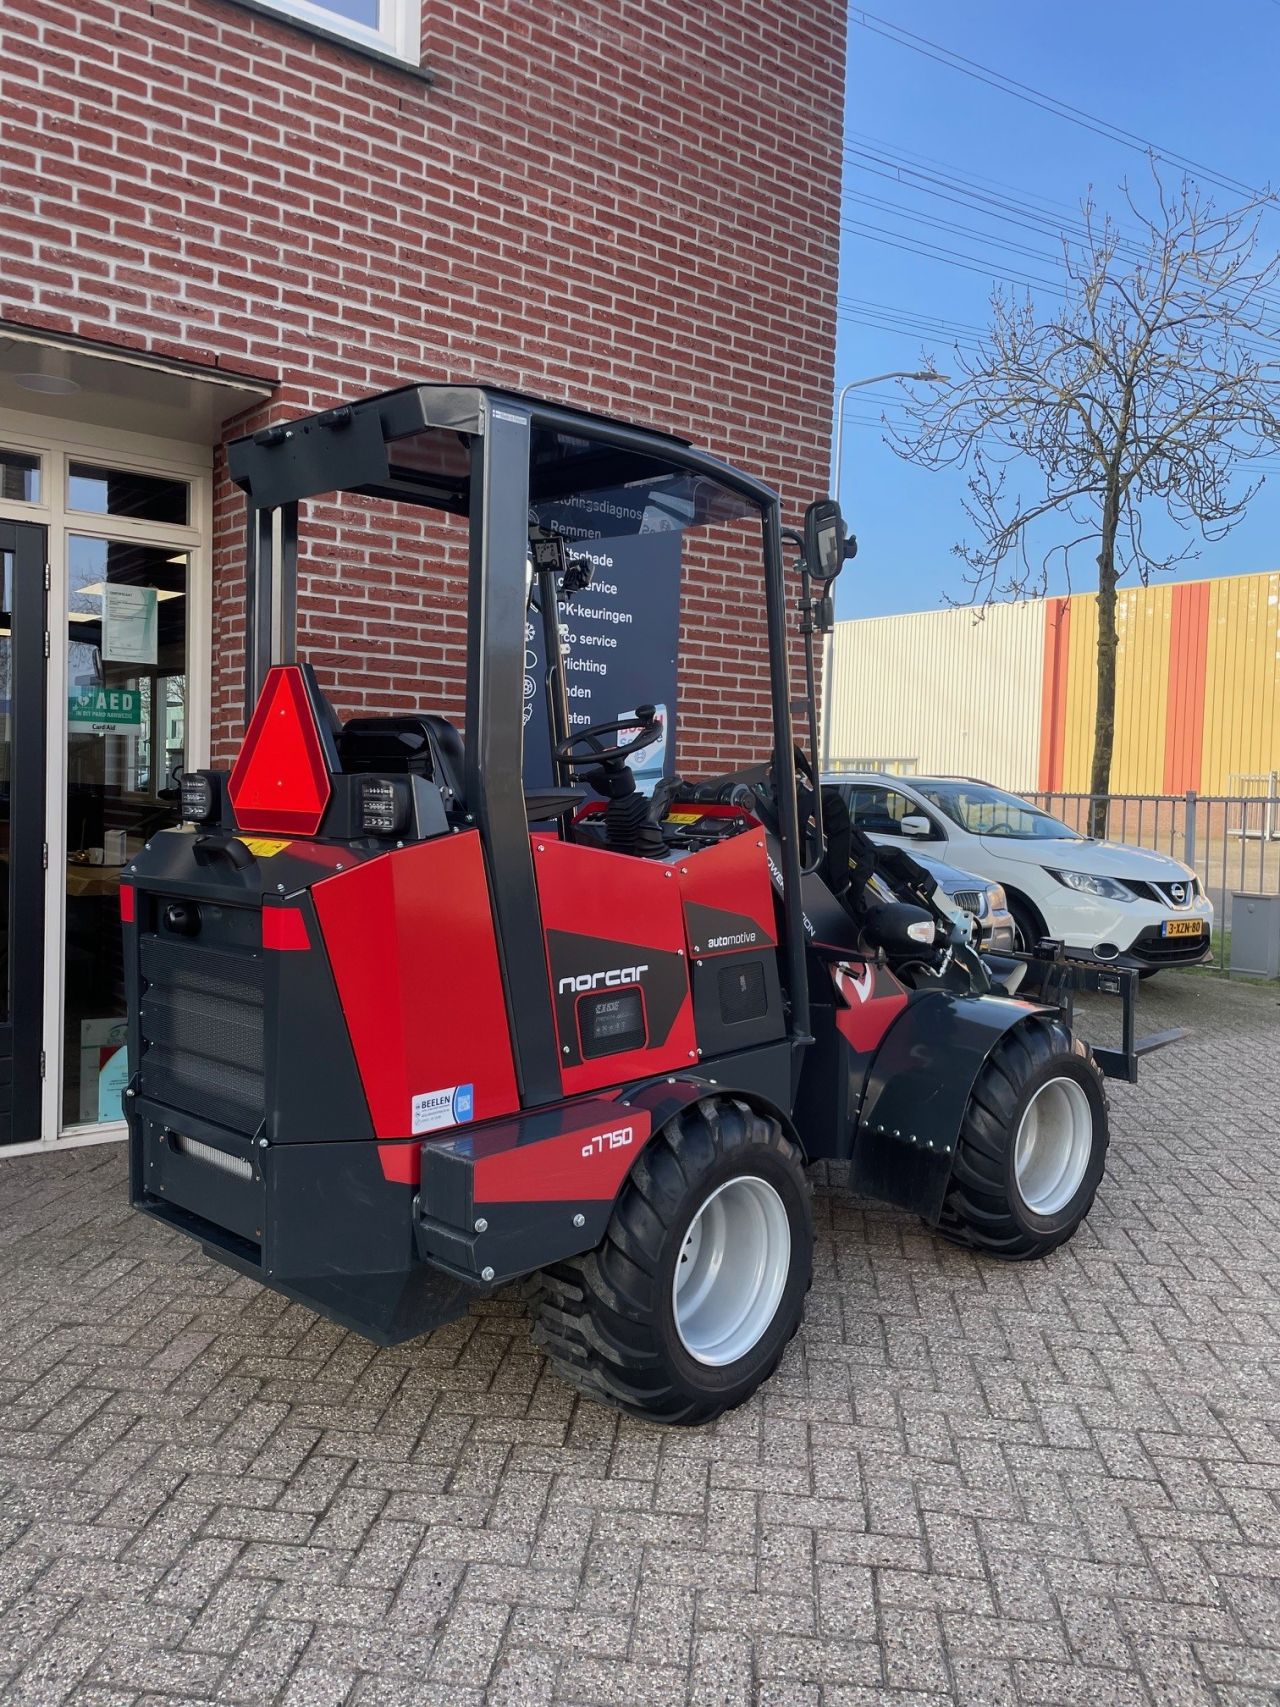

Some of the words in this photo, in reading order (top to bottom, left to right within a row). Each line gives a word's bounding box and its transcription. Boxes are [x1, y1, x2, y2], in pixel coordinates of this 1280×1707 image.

[553, 496, 648, 520] toringsdiagnose
[551, 520, 602, 539] Remmen
[566, 548, 613, 567] tschade
[558, 602, 632, 623] PK-keuringen
[580, 635, 617, 647] service
[563, 658, 607, 675] rlichting
[96, 692, 133, 711] AED
[1169, 922, 1200, 934] 3-XZN-80
[708, 932, 756, 948] automotive
[559, 965, 648, 994] norcar
[421, 1095, 450, 1109] BEELEN
[582, 1127, 632, 1157] a7750
